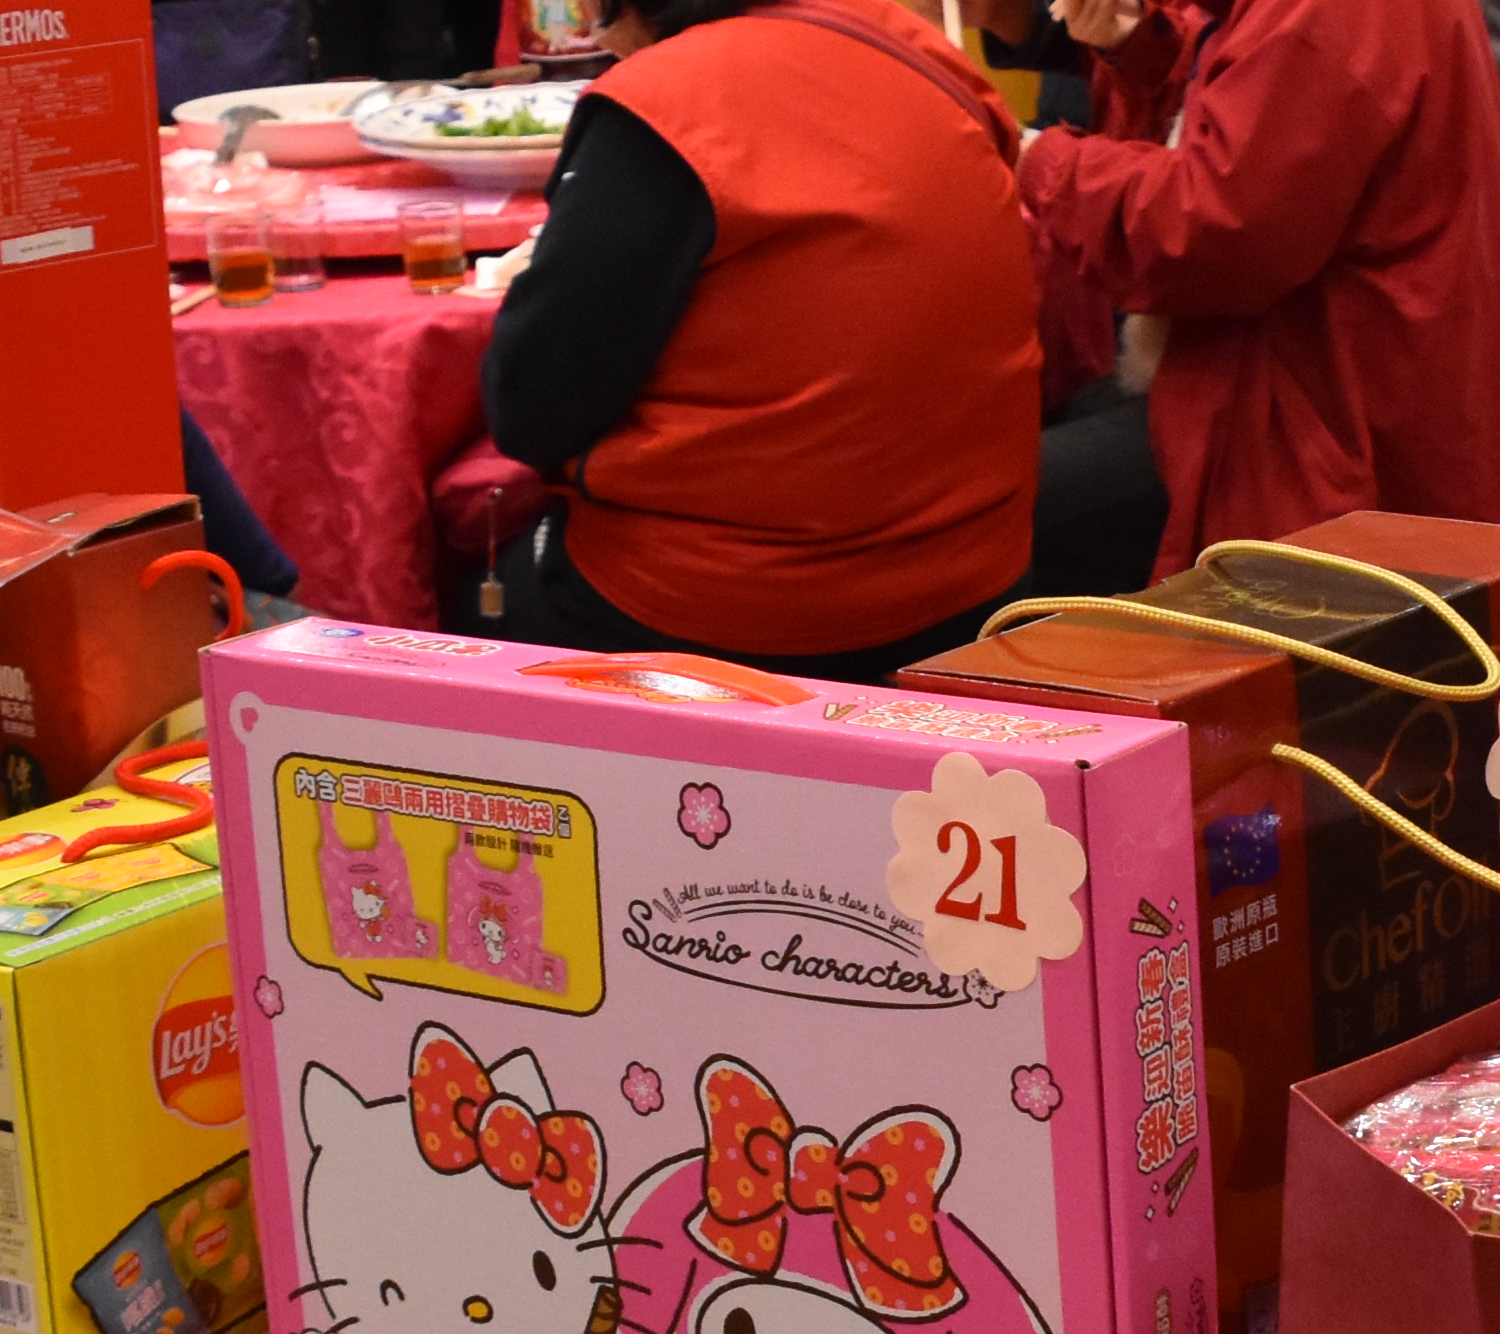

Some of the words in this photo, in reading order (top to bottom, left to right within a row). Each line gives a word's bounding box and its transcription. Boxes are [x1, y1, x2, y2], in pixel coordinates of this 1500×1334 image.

[678, 882, 700, 904] All
[704, 885, 723, 897] we
[727, 881, 760, 896] want
[764, 880, 777, 895] to
[781, 879, 800, 897] do
[802, 884, 816, 902] is
[819, 884, 834, 905] be
[873, 901, 887, 920] to
[934, 820, 1027, 931] 21
[622, 899, 750, 965] Sanrio
[761, 934, 959, 999] characters
[1213, 894, 1277, 942] 歐洲原瓶
[1216, 922, 1279, 968] 原裝進口
[159, 1010, 228, 1080] Lay's
[1138, 948, 1176, 1172] 樂迎新春
